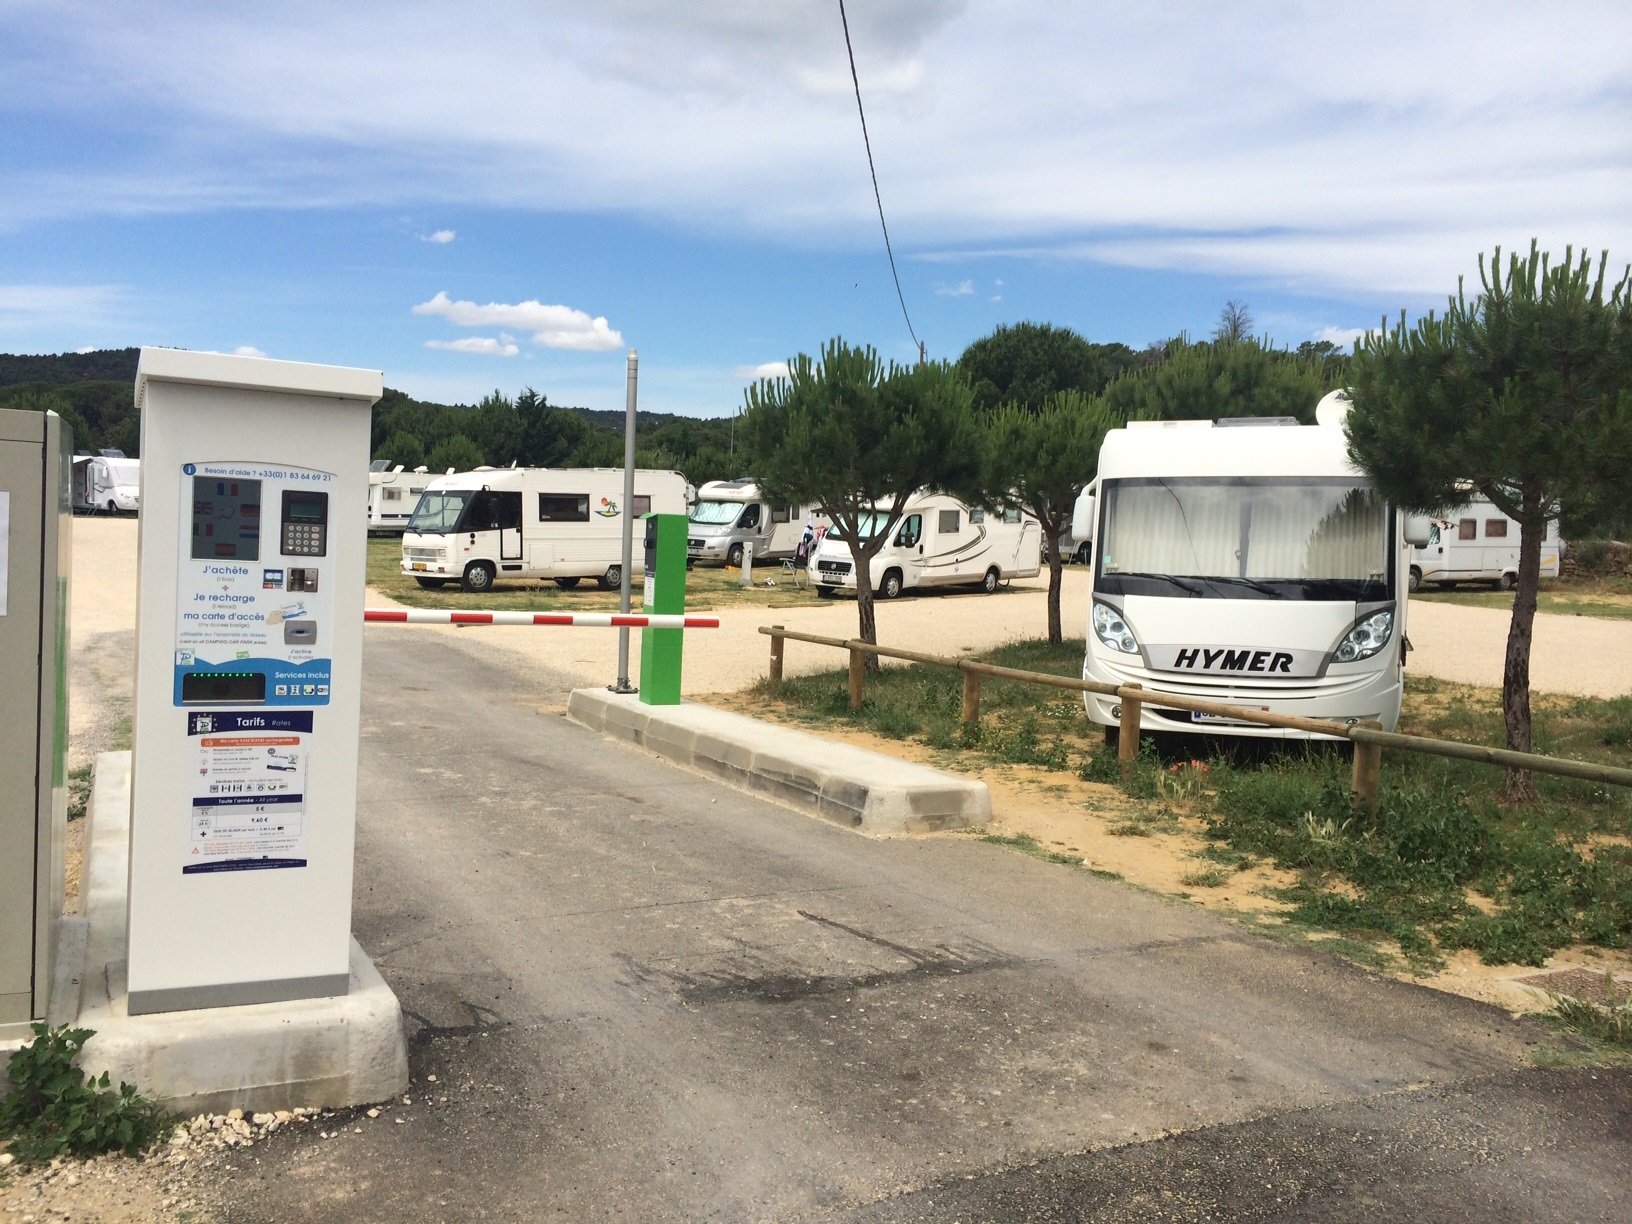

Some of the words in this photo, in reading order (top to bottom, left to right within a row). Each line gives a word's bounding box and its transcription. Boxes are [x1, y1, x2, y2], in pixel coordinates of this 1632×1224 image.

[204, 467, 227, 475] Besoin
[228, 468, 251, 476] d'aide
[258, 470, 287, 479] +33(0)1
[289, 472, 299, 480] 83
[202, 566, 249, 575] J'achète
[193, 593, 206, 601] Je
[208, 594, 255, 604] recharge
[228, 612, 265, 621] d'accès
[1173, 648, 1294, 673] HYMER
[274, 671, 306, 679] Services
[308, 672, 330, 680] inclus
[236, 717, 265, 727] Tarifs
